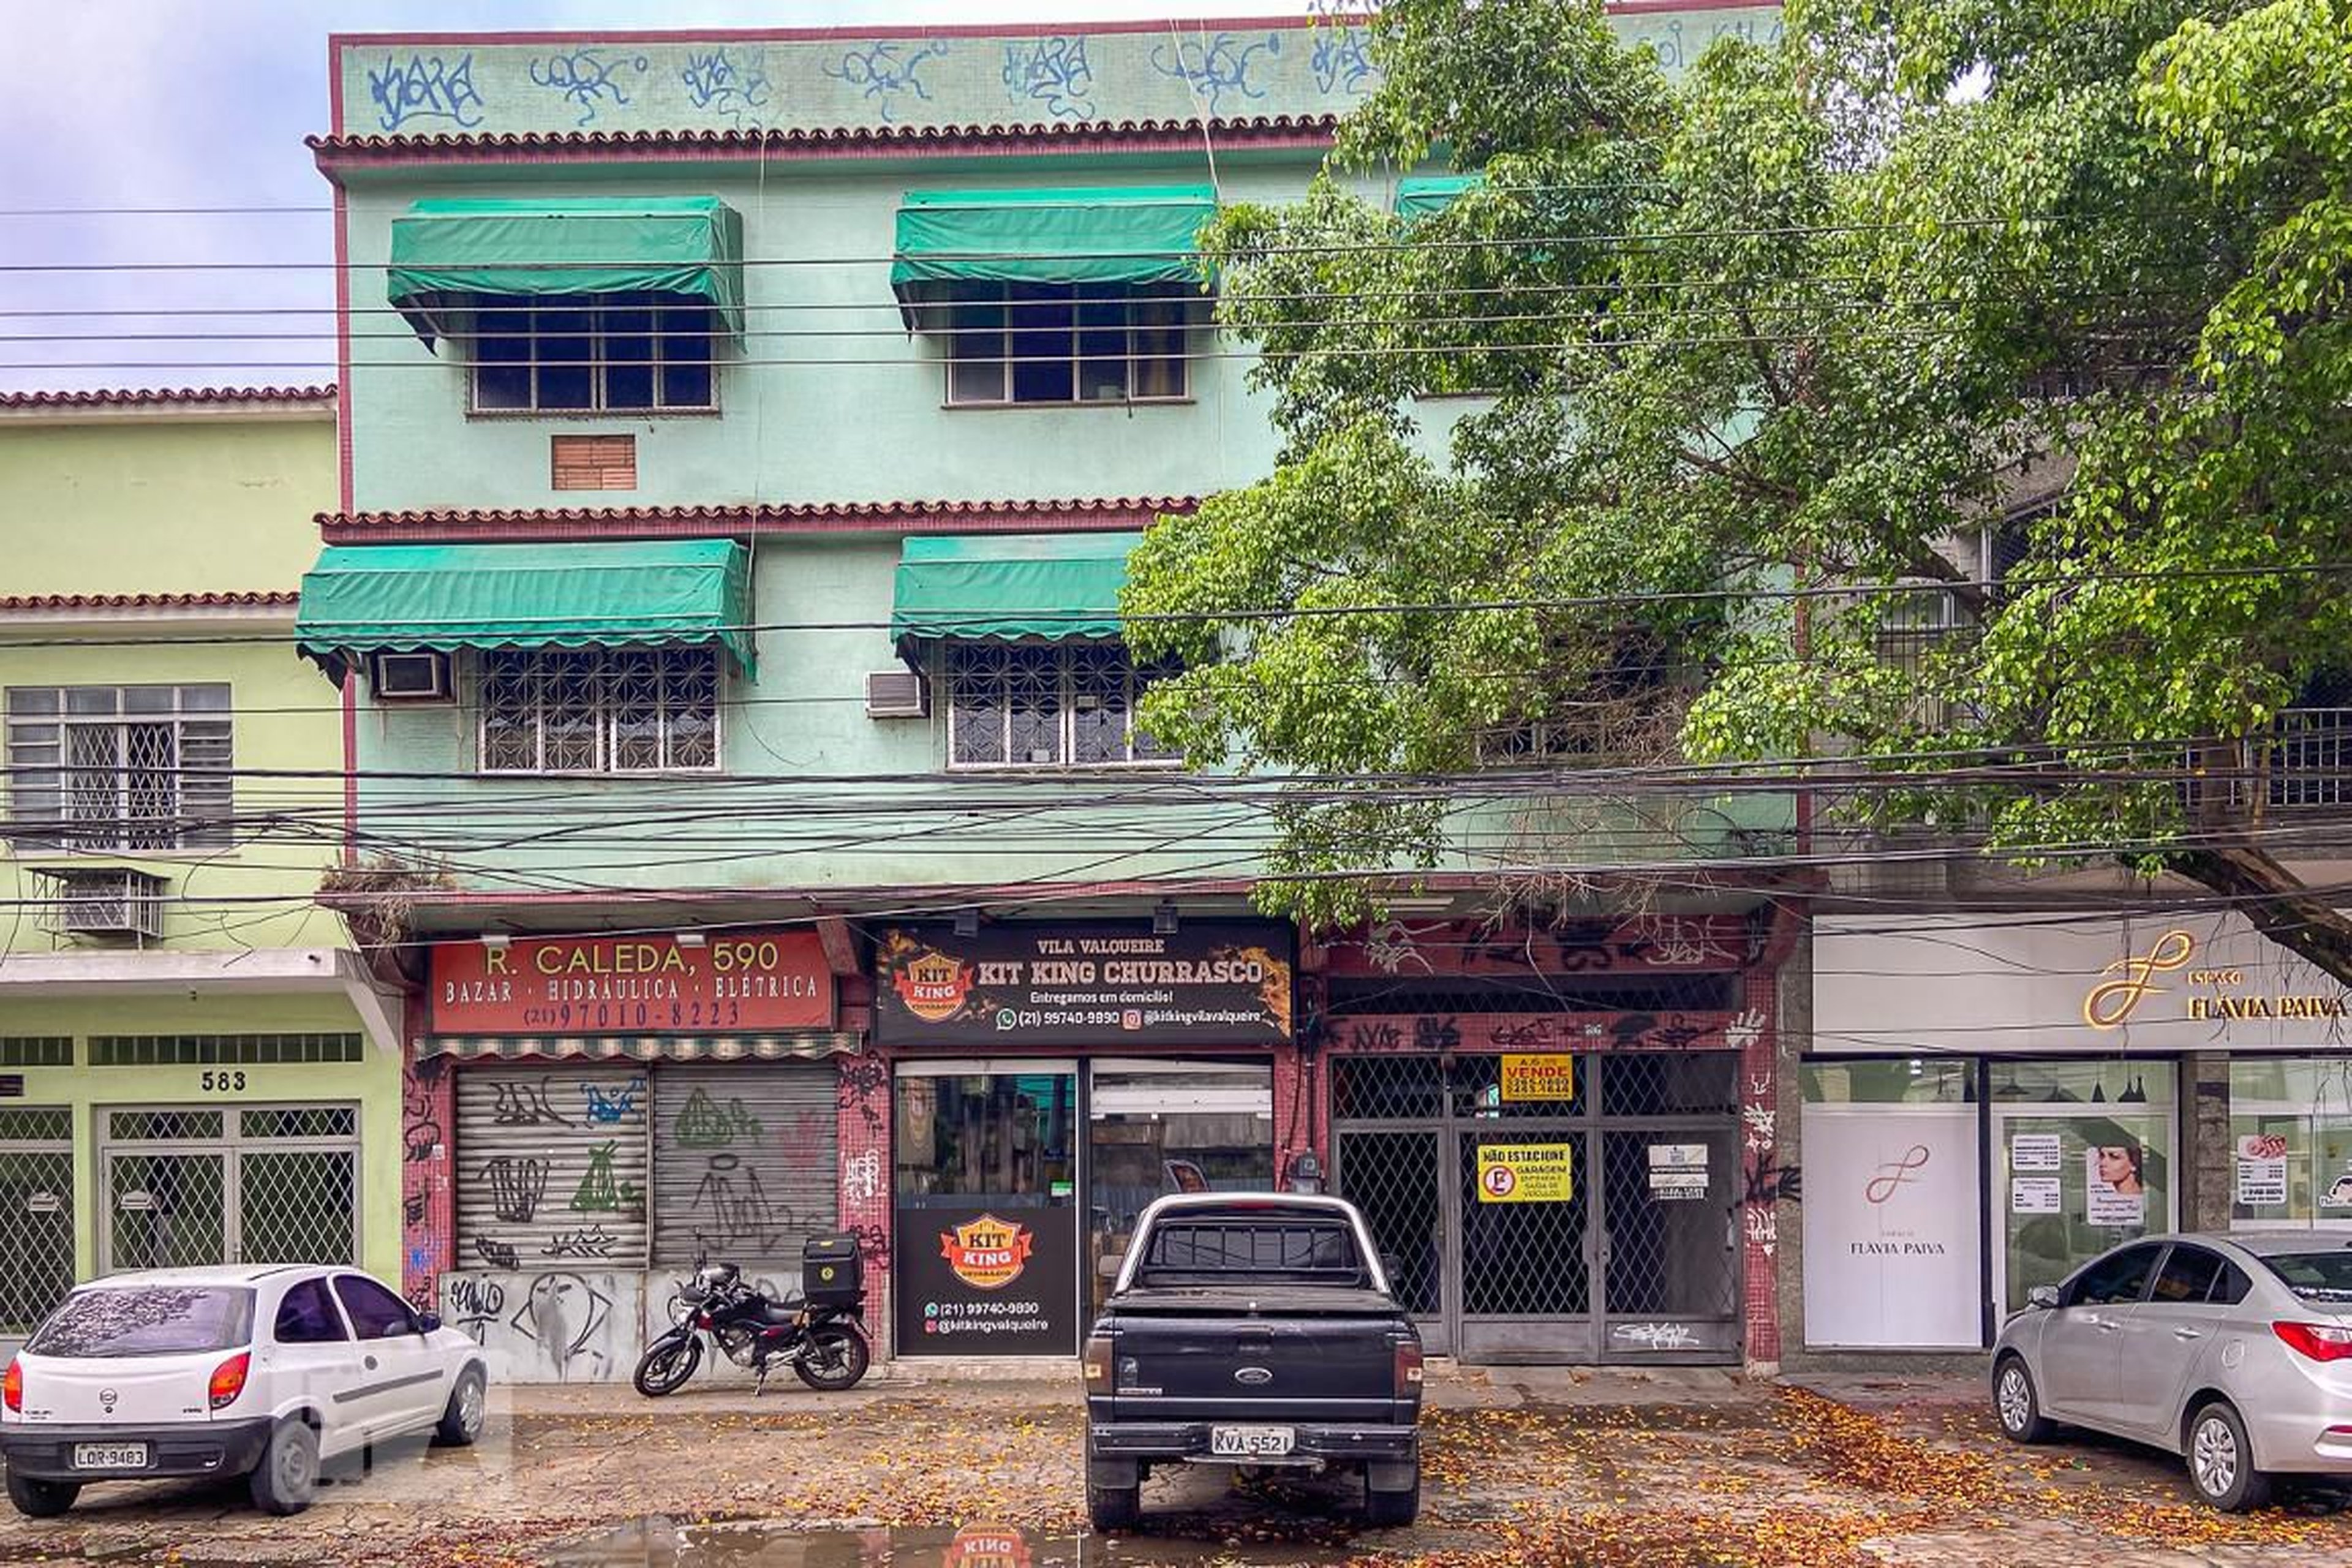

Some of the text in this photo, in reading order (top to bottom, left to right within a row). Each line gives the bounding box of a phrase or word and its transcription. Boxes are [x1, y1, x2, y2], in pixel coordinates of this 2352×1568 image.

[1038, 939, 1164, 954] VILA VALQUEIRE
[487, 941, 778, 977] R. CALEDA, 590
[918, 968, 951, 982] KIT
[978, 960, 1263, 985] KIT KING CHURRASCO
[445, 971, 817, 1003] BAZAR HIDRÁULICA ELÉTRICA
[913, 985, 957, 999] KING
[1030, 992, 1098, 1006] Entregamos
[1100, 993, 1117, 1003] em
[2277, 995, 2348, 1020] PAIVA
[1019, 1011, 1042, 1027] (21)
[1506, 1066, 1569, 1078] VENDE
[202, 1071, 246, 1091] 583
[1483, 1150, 1564, 1162] NÃO ESTACIONE
[968, 1233, 1008, 1248] KIT
[1904, 1243, 1945, 1254] PAIVA
[963, 1250, 1012, 1266] KING
[940, 1303, 963, 1317] (21)
